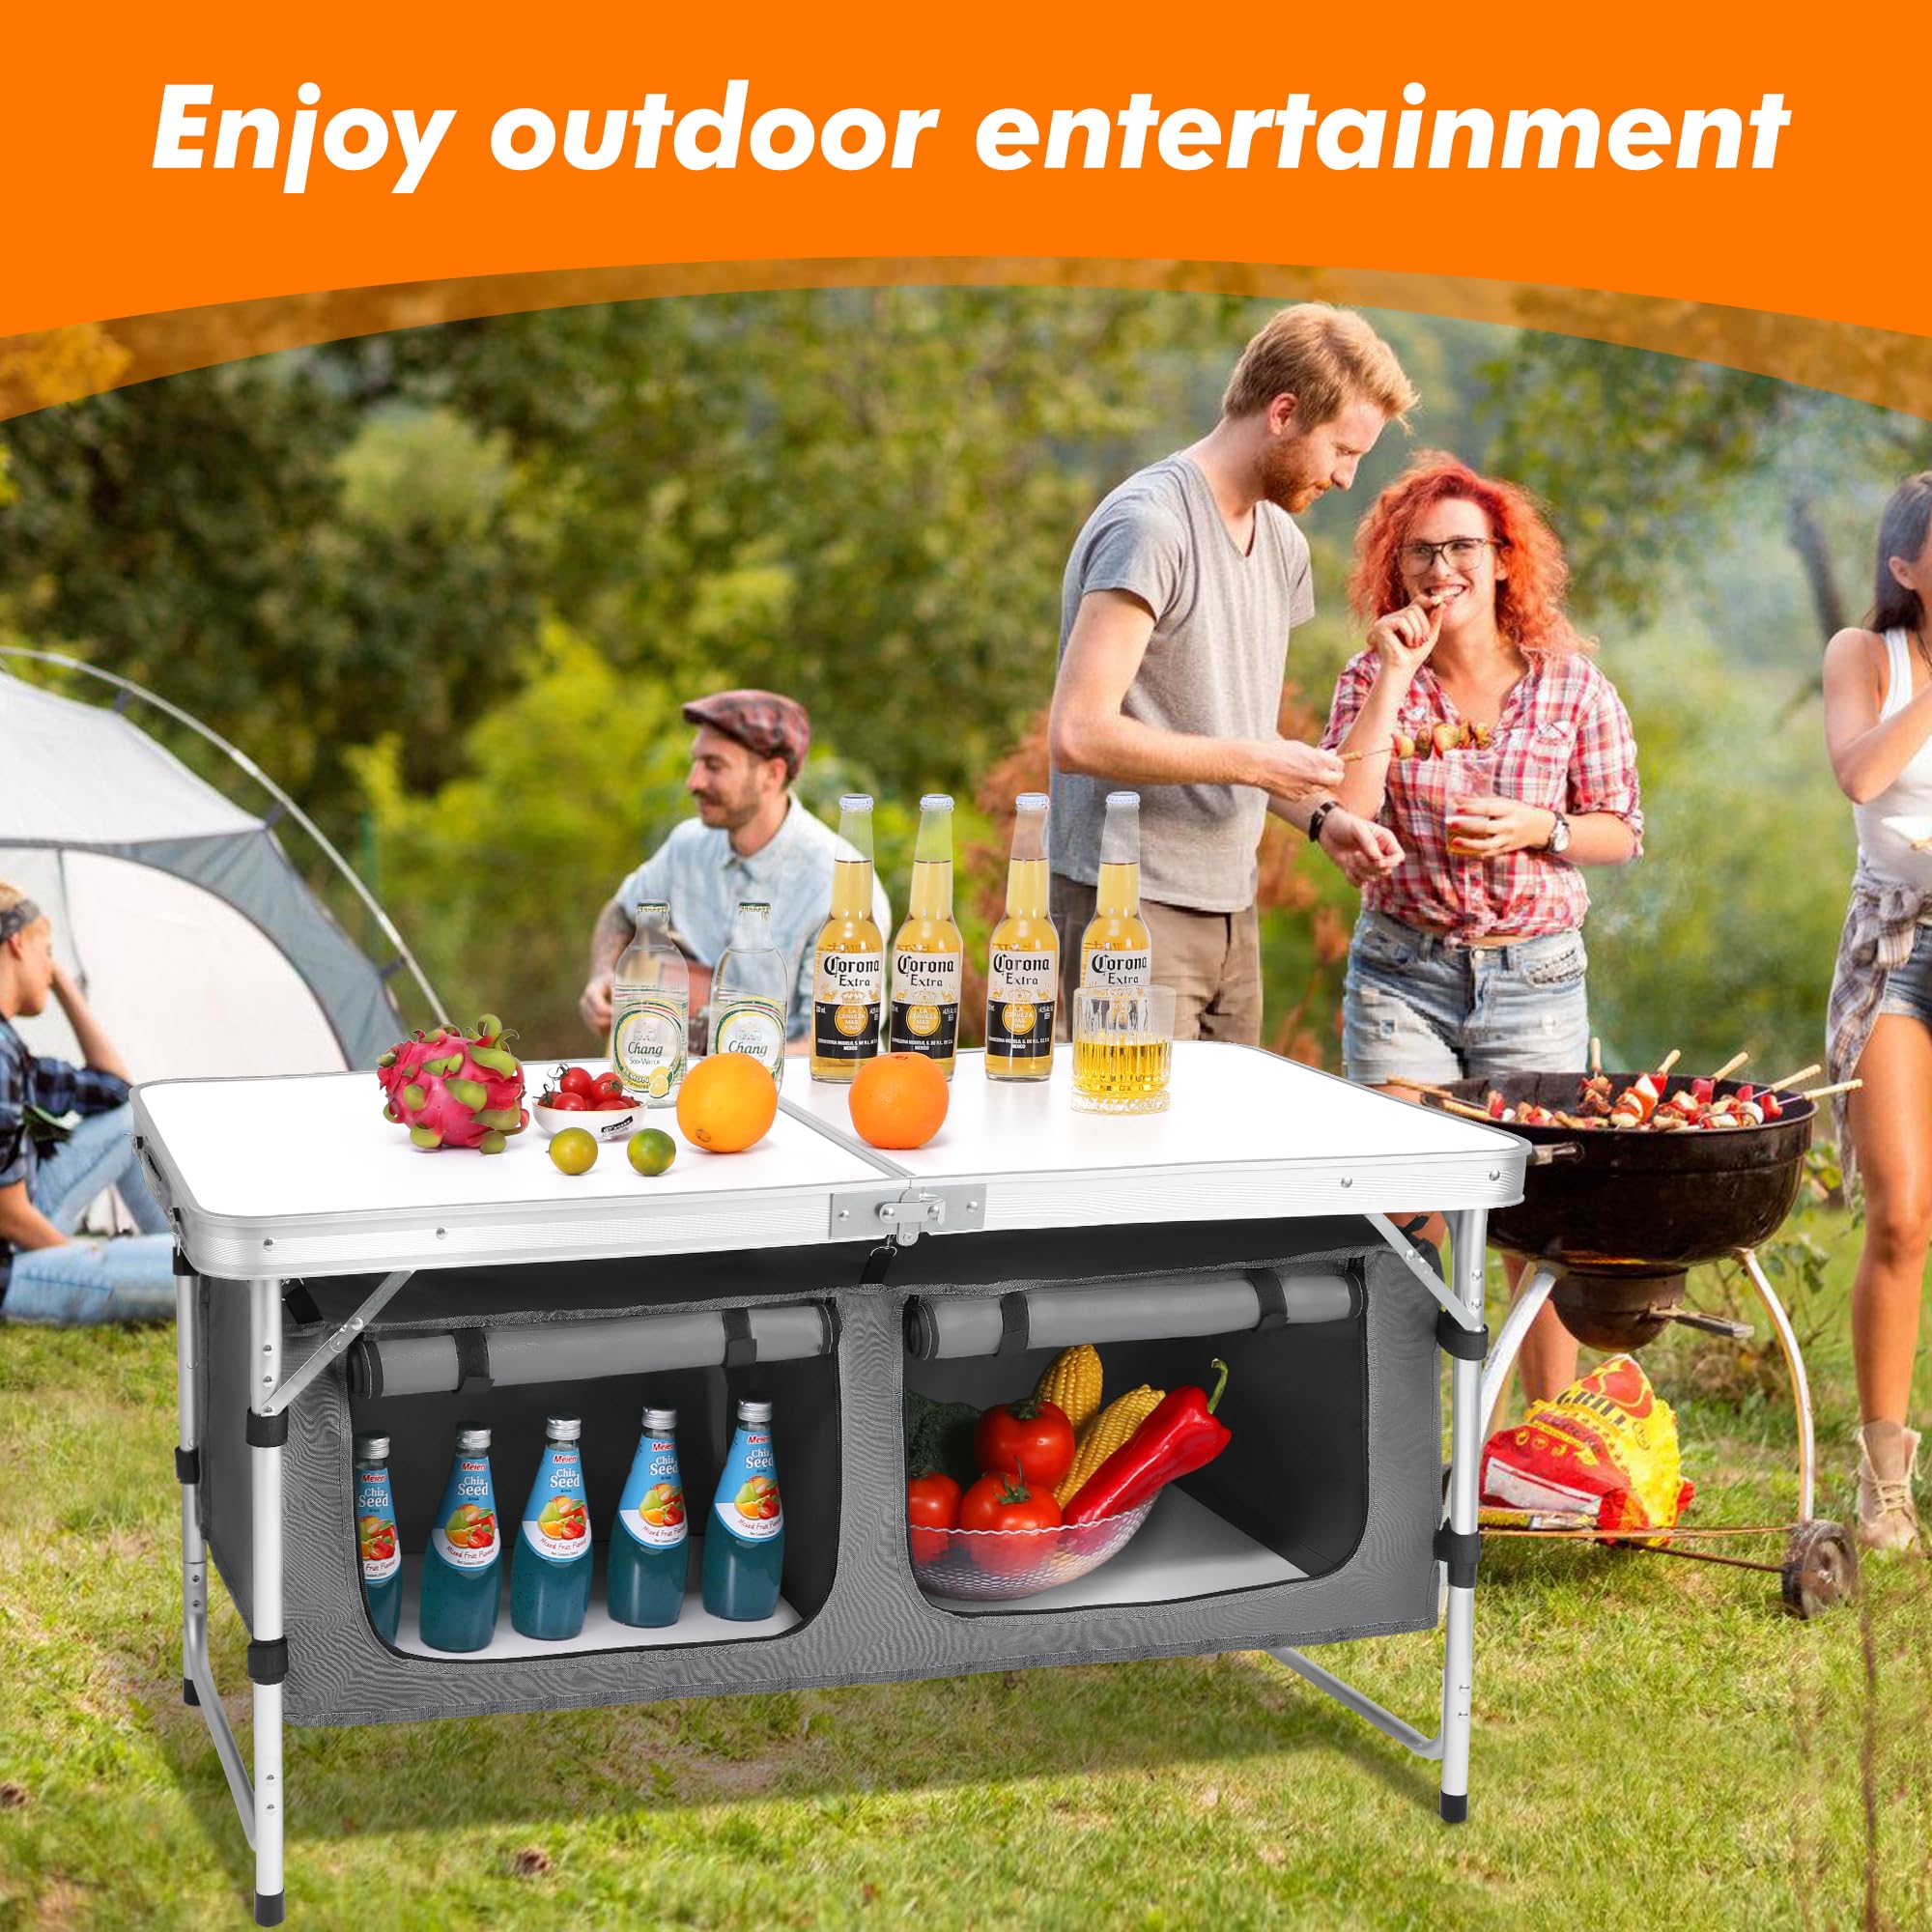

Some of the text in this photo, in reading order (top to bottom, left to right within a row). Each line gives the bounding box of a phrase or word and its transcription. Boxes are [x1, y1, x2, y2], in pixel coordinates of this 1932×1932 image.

[823, 954, 880, 979] Corona
[897, 954, 954, 978] Corona
[993, 953, 1050, 976] Corona
[1092, 953, 1148, 977] Corona
[838, 975, 870, 987] Extra
[911, 974, 943, 987] Extra
[1006, 973, 1038, 985] Extra
[1108, 972, 1139, 985] Extra
[628, 1041, 664, 1058] Chang
[728, 1040, 768, 1058] Chang
[656, 1455, 675, 1465] Chia
[751, 1448, 771, 1459] Chia
[649, 1460, 678, 1476] Seed
[745, 1456, 774, 1468] Seed
[555, 1468, 577, 1478] Chia
[464, 1476, 484, 1486] Chia
[550, 1474, 580, 1488] Seed
[364, 1488, 384, 1496] Chia
[457, 1483, 489, 1496] Seed
[358, 1494, 389, 1508] Seed
